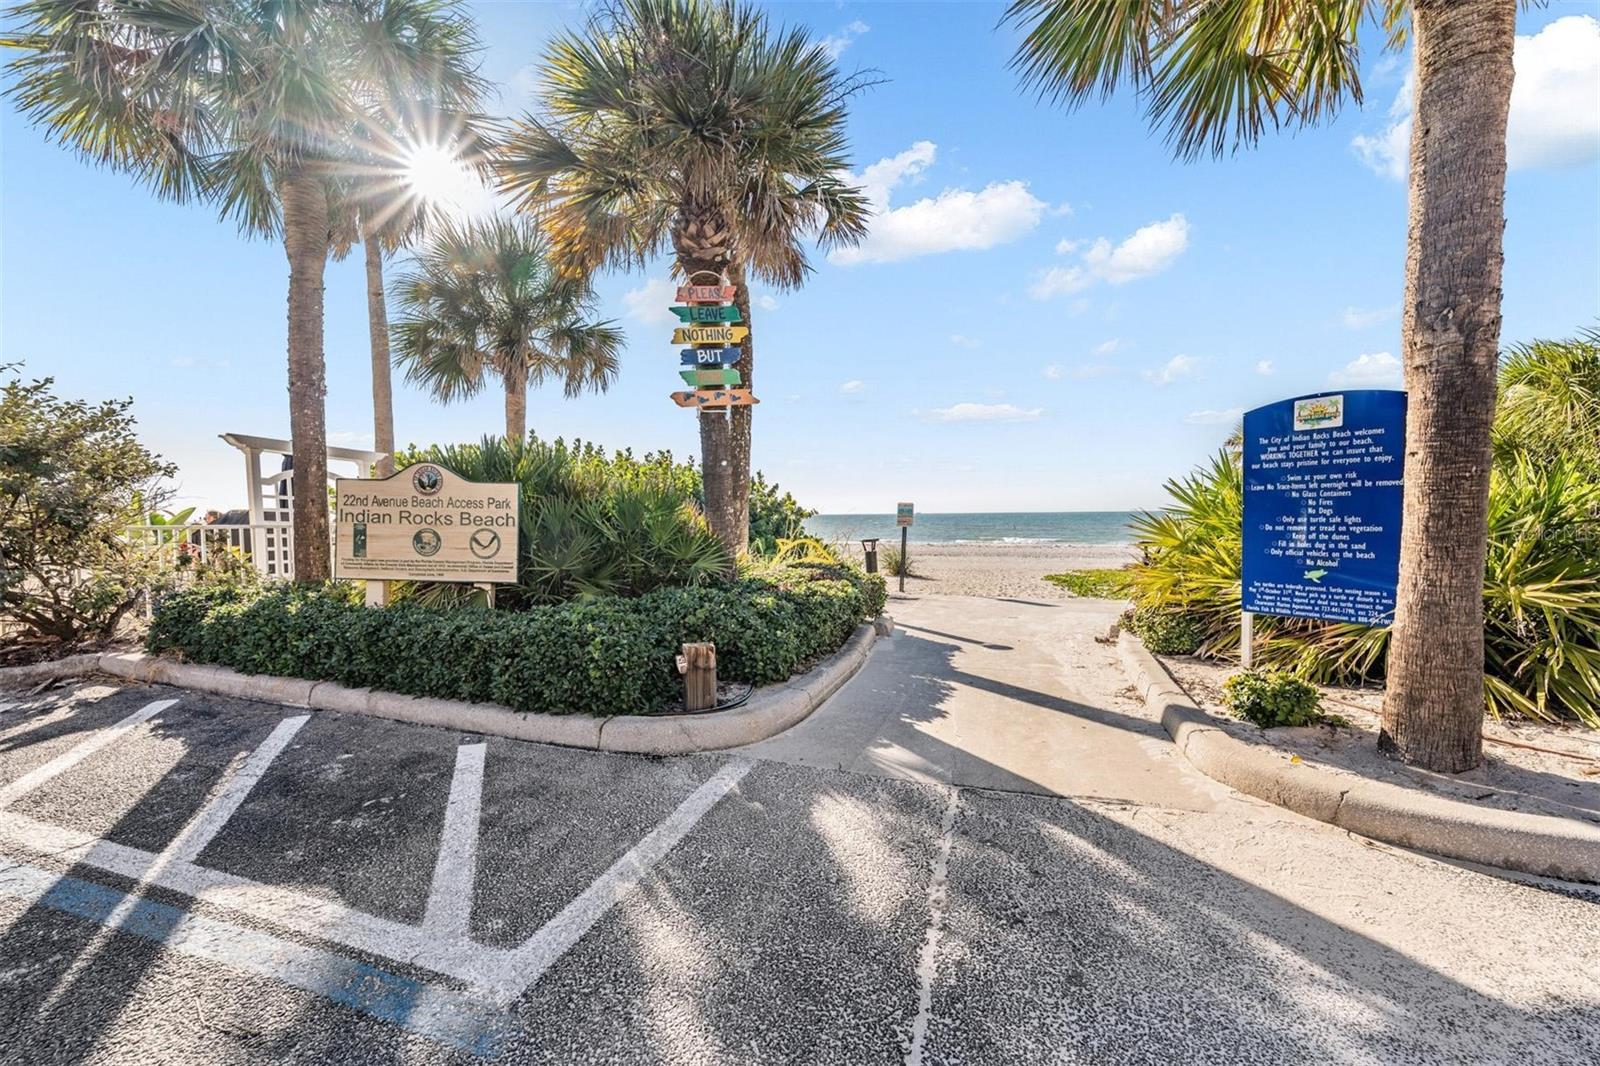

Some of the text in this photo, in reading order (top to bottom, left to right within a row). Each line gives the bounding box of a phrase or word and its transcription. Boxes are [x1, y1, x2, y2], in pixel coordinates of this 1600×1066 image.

[690, 308, 726, 320] LEAVE
[682, 328, 733, 342] NOTHING
[697, 350, 723, 363] BUT
[1333, 430, 1351, 438] Beach
[1354, 428, 1385, 436] welcomes
[1293, 444, 1306, 452] your
[1353, 437, 1374, 445] beach.
[1289, 450, 1318, 458] TOGETHER
[1297, 460, 1318, 468] pristine
[1374, 455, 1394, 464] enjoy.
[1314, 474, 1326, 483] your
[1346, 471, 1357, 479] risk
[1321, 482, 1348, 490] overnight
[1376, 478, 1404, 486] removed
[344, 495, 511, 509] 22nd Avenue Beach Access Park
[1319, 507, 1333, 516] Dogs
[340, 509, 516, 527] Indian Rocks Beach
[1282, 516, 1295, 524] Only
[1344, 516, 1362, 525] lights
[1349, 525, 1383, 534] vegetation
[1292, 533, 1306, 541] Keep
[1315, 542, 1326, 550] dug
[1271, 548, 1283, 557] Only
